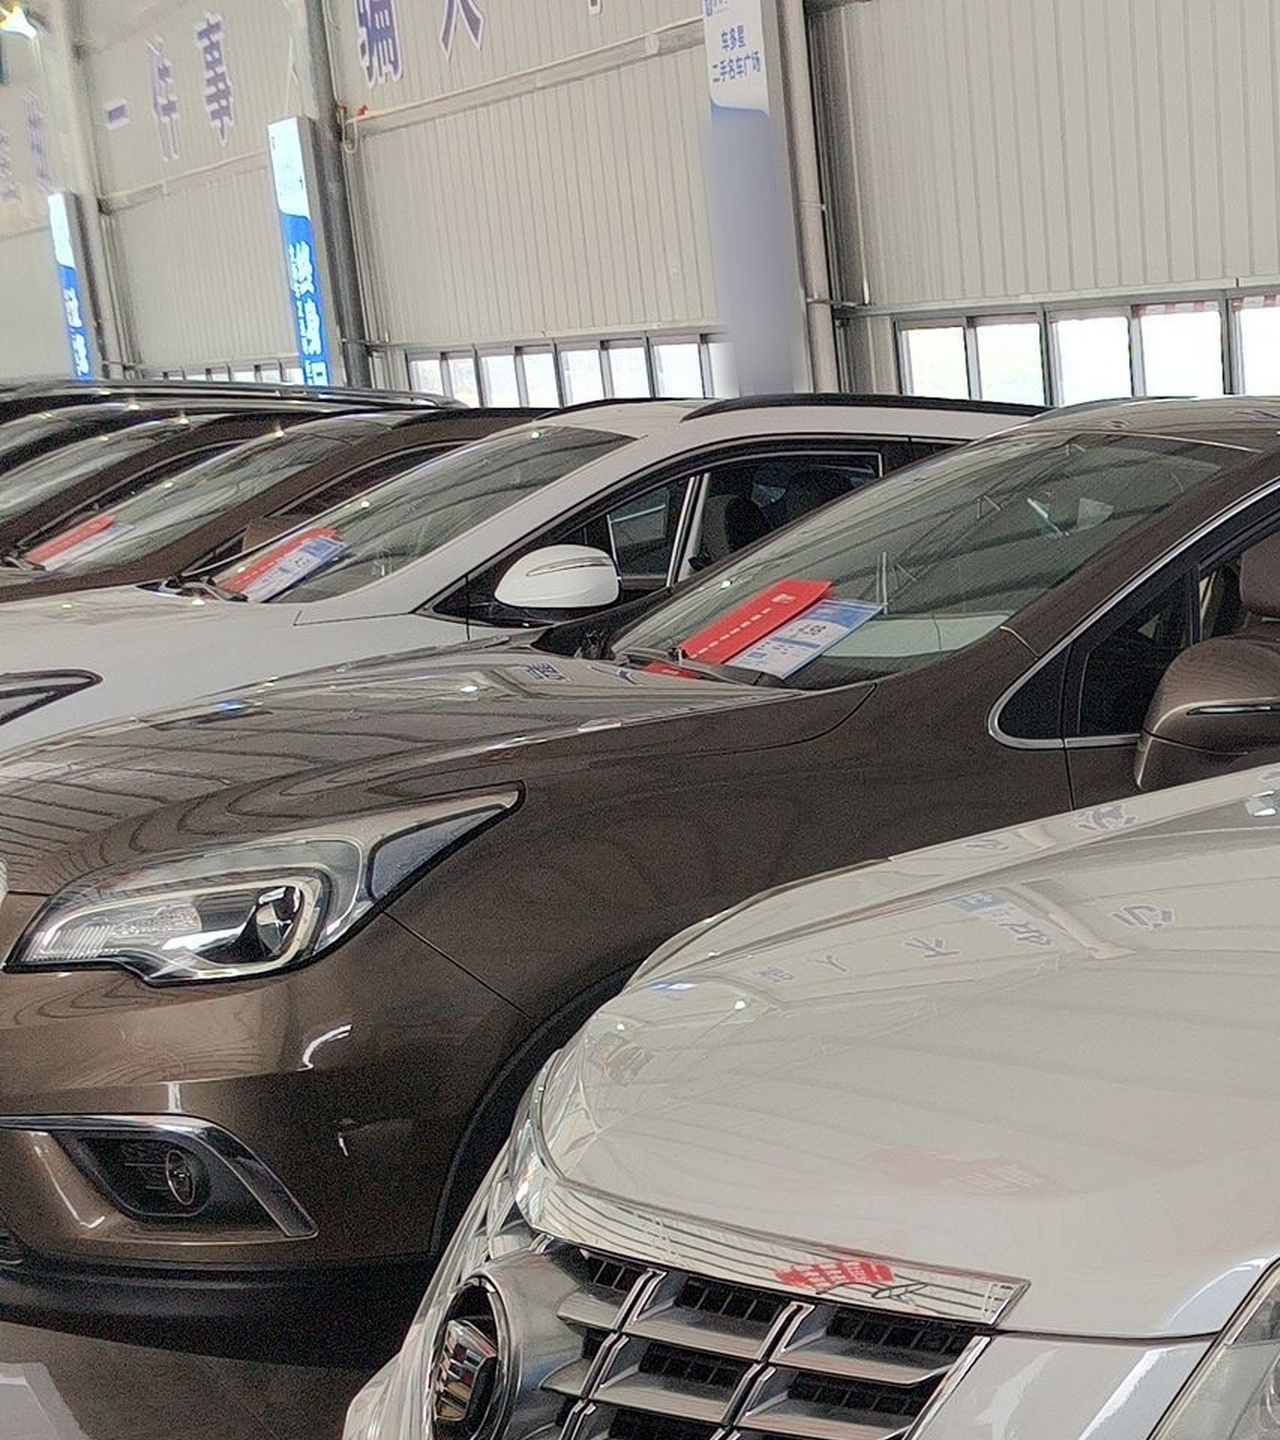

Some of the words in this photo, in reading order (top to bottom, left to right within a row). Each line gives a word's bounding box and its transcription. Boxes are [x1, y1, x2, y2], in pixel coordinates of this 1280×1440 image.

[712, 50, 762, 83] 二手名车广场
